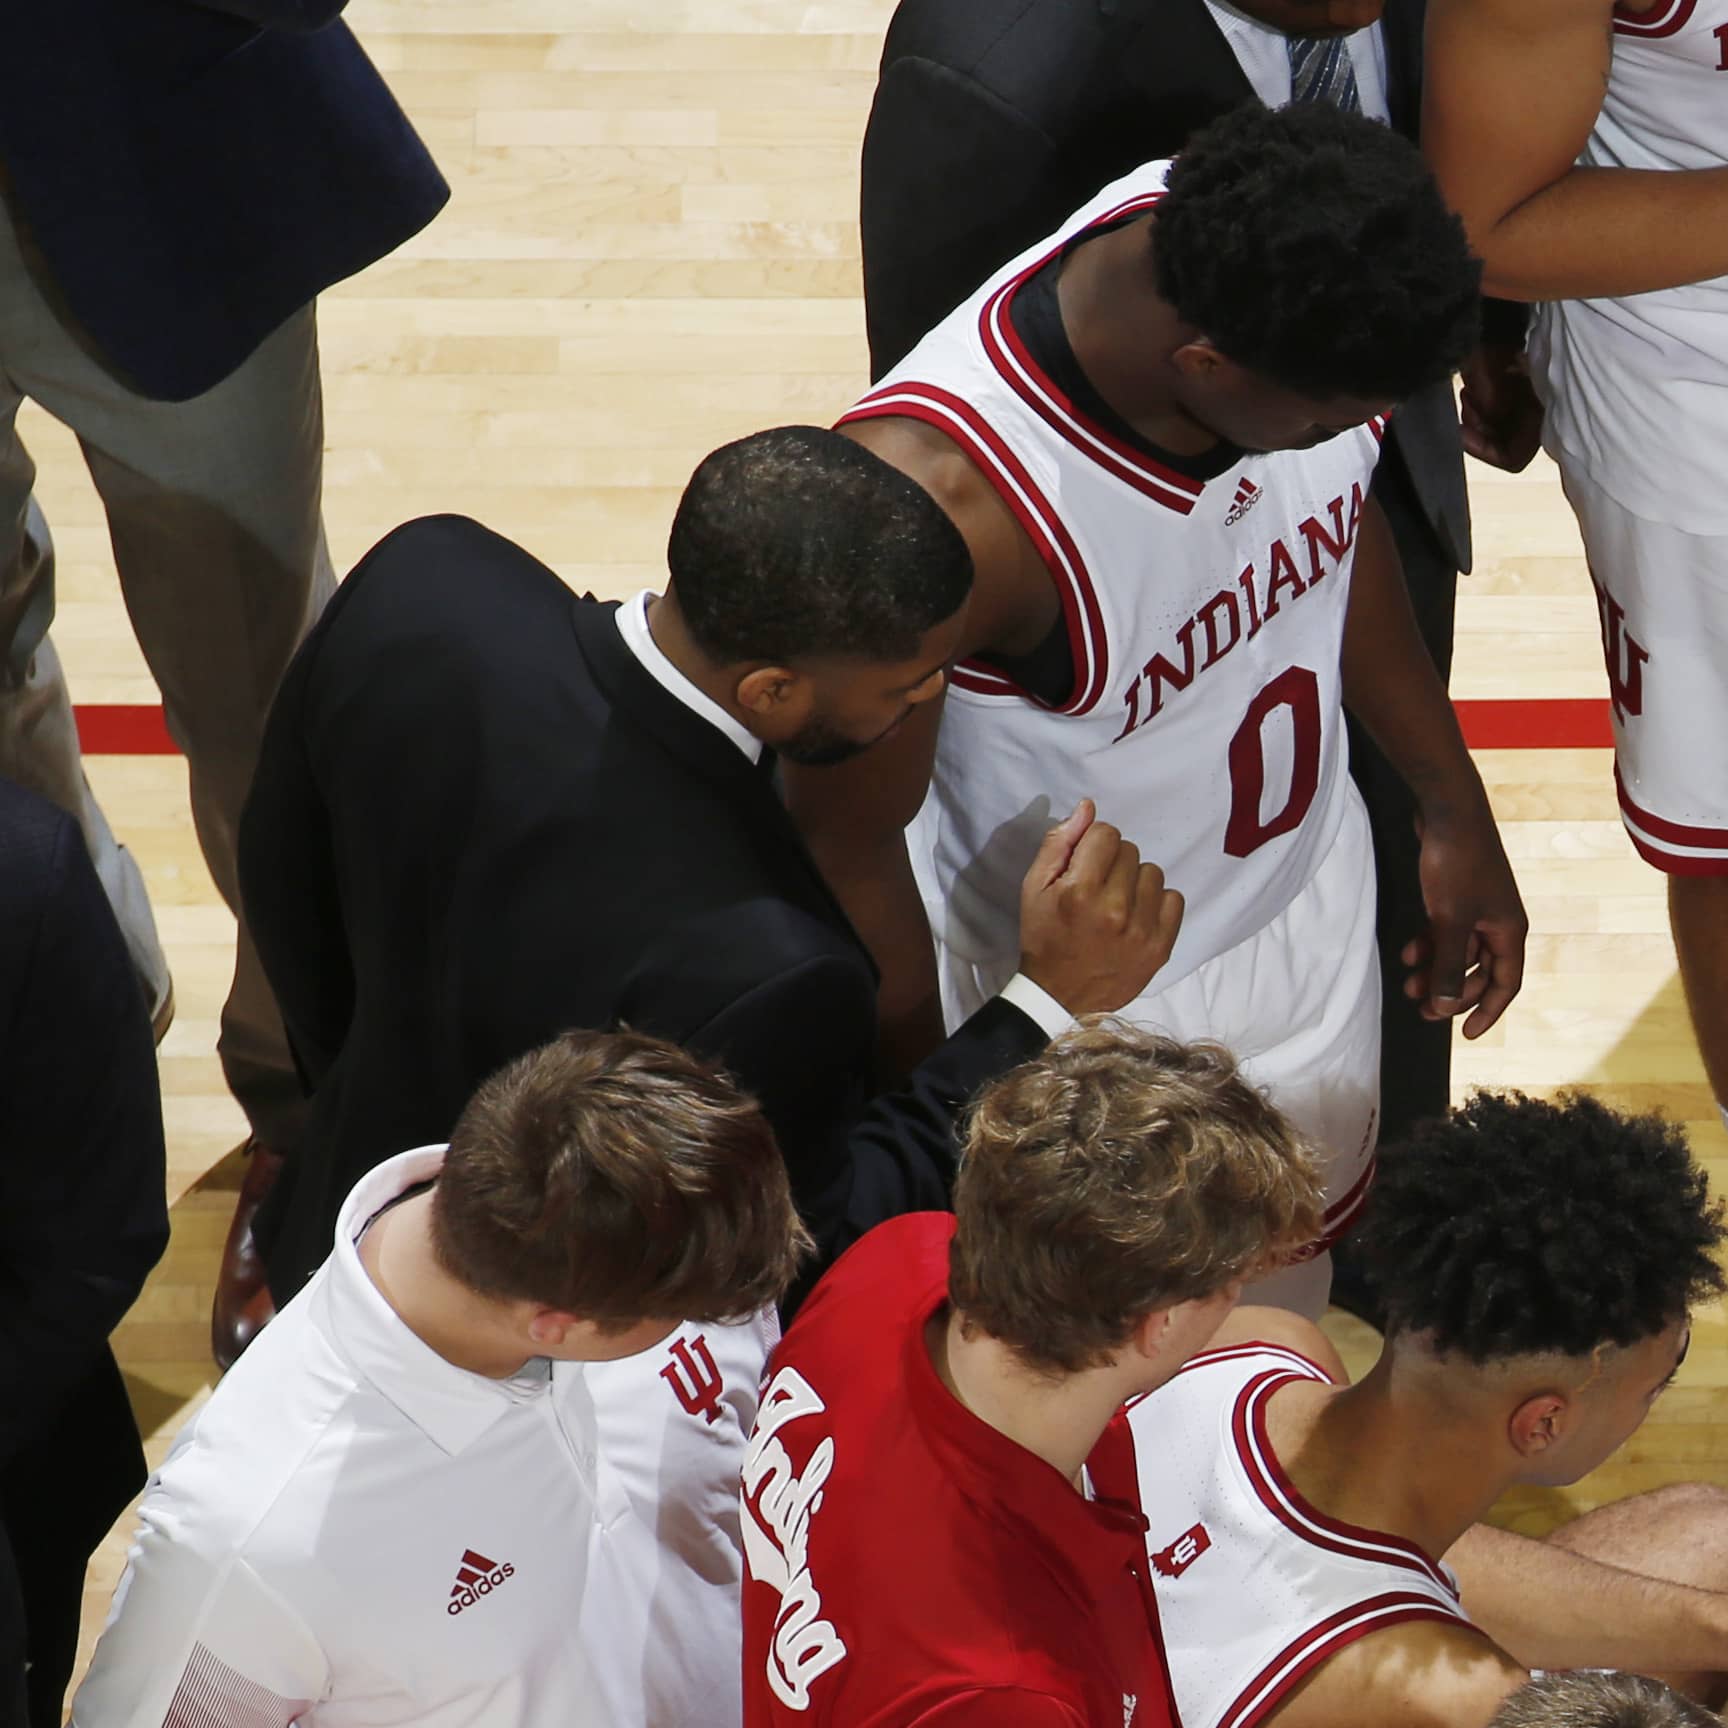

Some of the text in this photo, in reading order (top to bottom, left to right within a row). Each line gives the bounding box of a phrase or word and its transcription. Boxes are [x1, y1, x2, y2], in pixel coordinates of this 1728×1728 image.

[1225, 486, 1264, 526] adidas
[1113, 482, 1365, 744] INDIANA
[1224, 666, 1320, 858] 0
[447, 1563, 514, 1616] adidas
